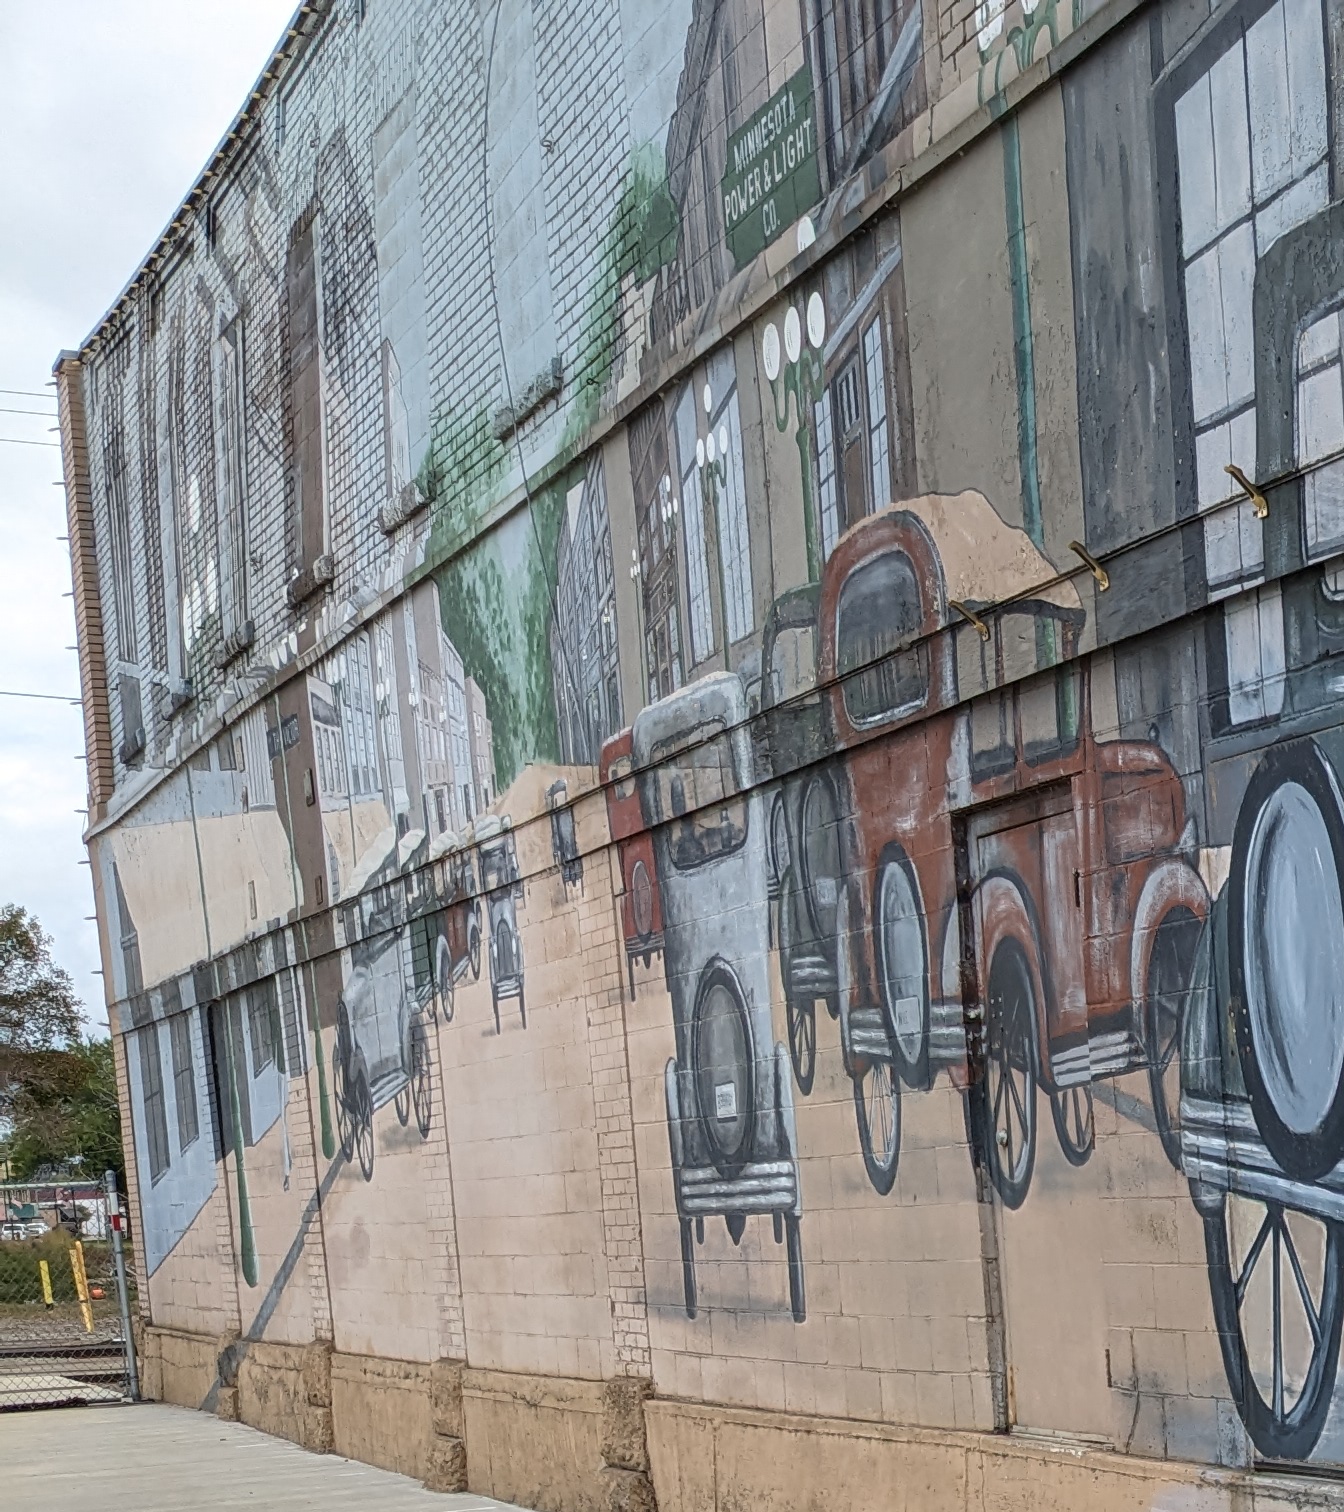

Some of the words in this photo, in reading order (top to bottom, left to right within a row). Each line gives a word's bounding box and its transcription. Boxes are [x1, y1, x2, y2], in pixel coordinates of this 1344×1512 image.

[724, 166, 763, 228] POWER
[763, 158, 772, 193] &
[773, 116, 811, 183] LIGHT
[733, 90, 796, 174] MINNESOTA
[762, 198, 781, 237] CO.
